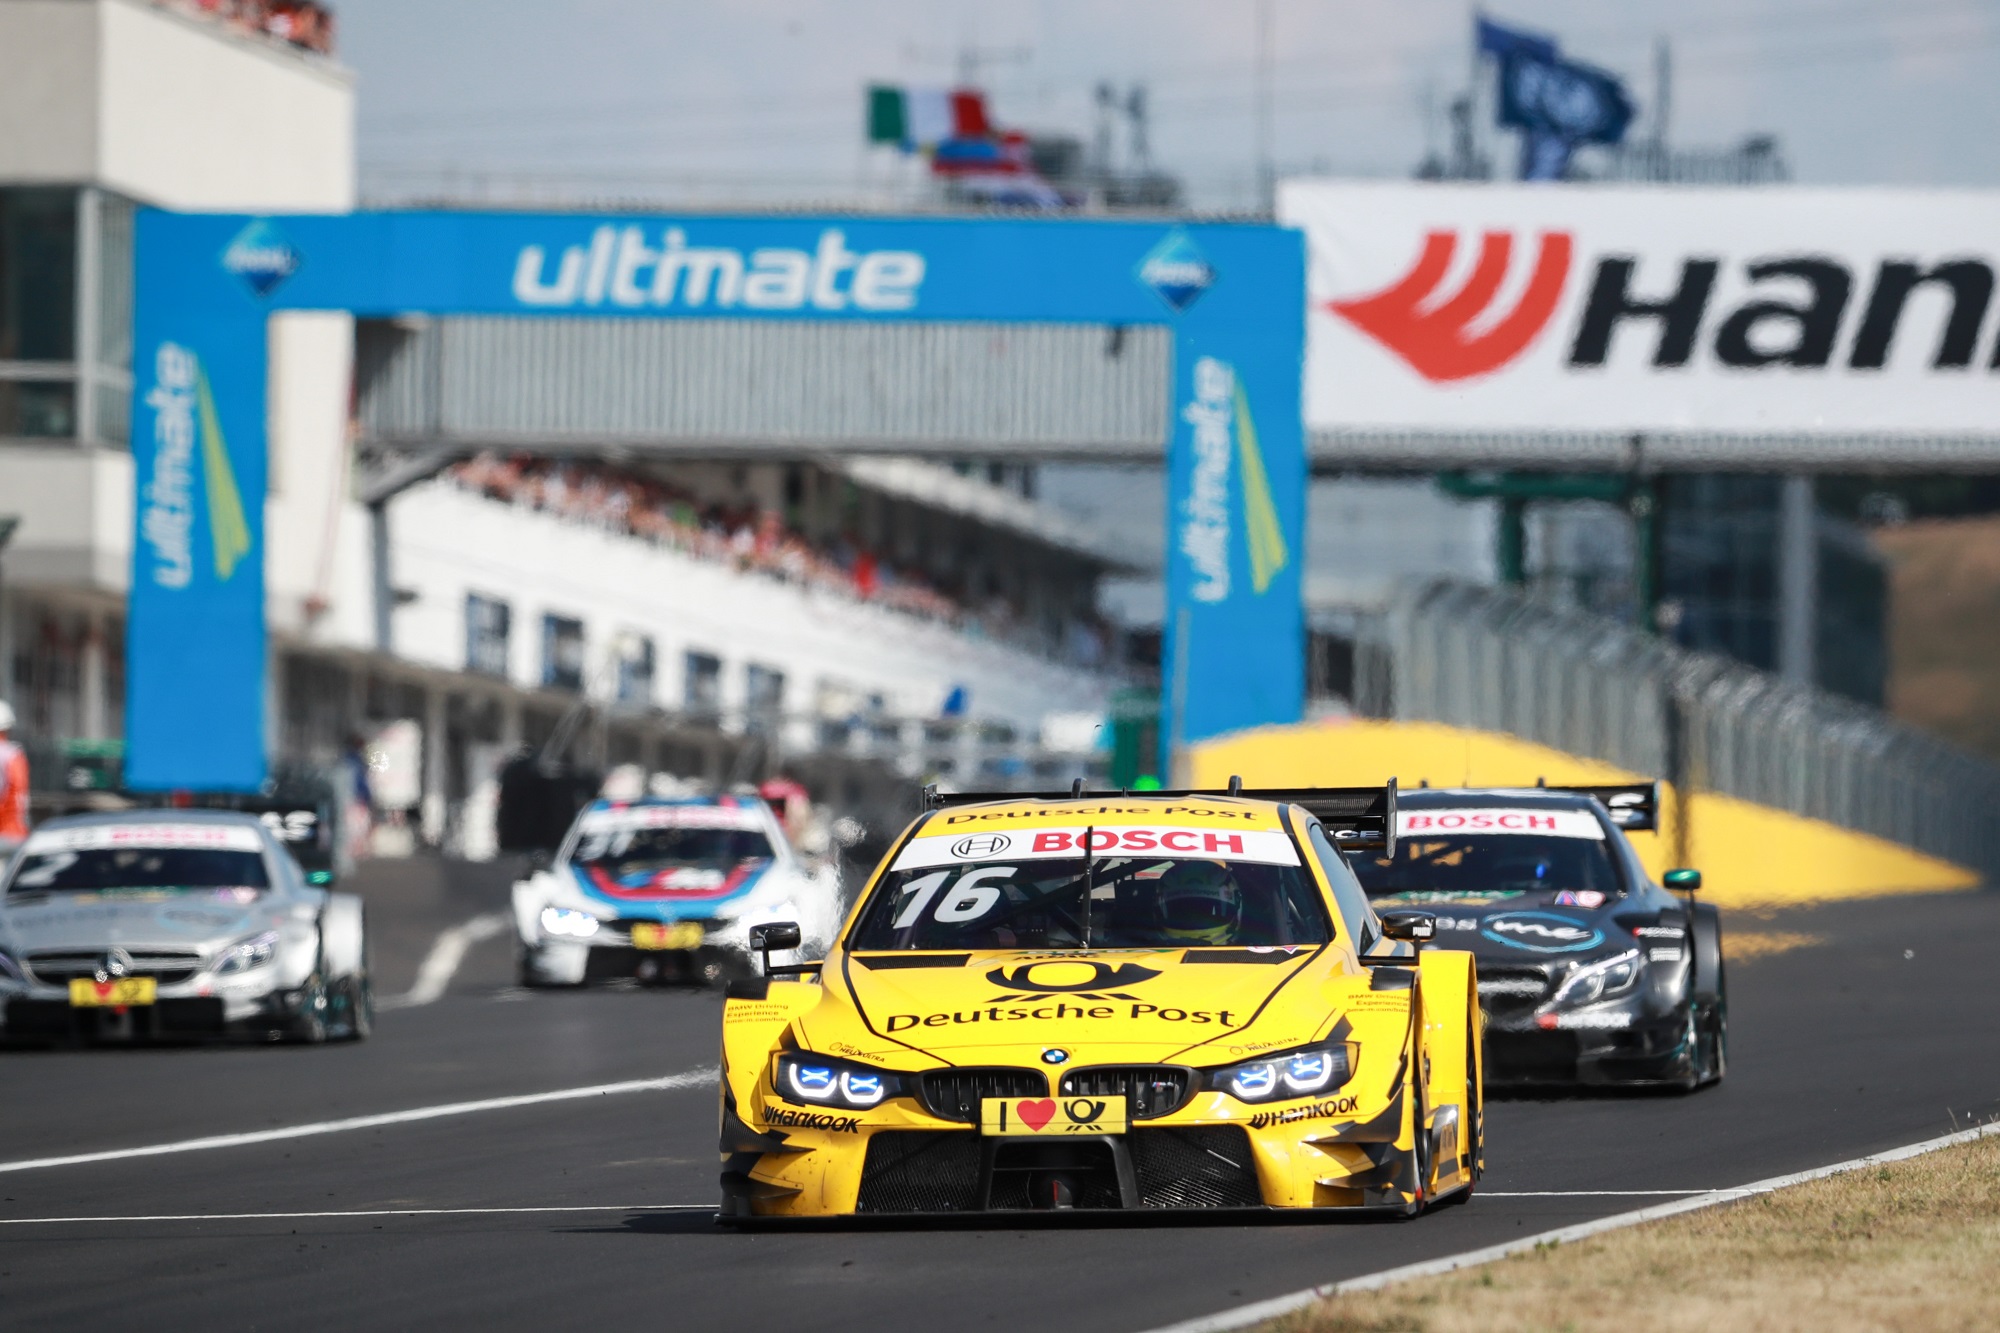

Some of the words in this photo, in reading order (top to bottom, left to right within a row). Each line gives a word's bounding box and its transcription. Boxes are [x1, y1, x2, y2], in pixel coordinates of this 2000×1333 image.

[514, 226, 925, 310] ultimate
[1565, 255, 2000, 370] Han
[143, 342, 197, 588] ultimate
[1182, 357, 1234, 602] ultimate
[946, 806, 1151, 825] Deutsche
[1164, 806, 1258, 821] Post
[1407, 814, 1557, 831] BOSCH
[1031, 829, 1245, 854] BOSCH
[892, 866, 1019, 930] 16
[886, 1003, 1115, 1033] Deutsche
[1130, 1003, 1236, 1028] Post
[1000, 1101, 1007, 1132] I
